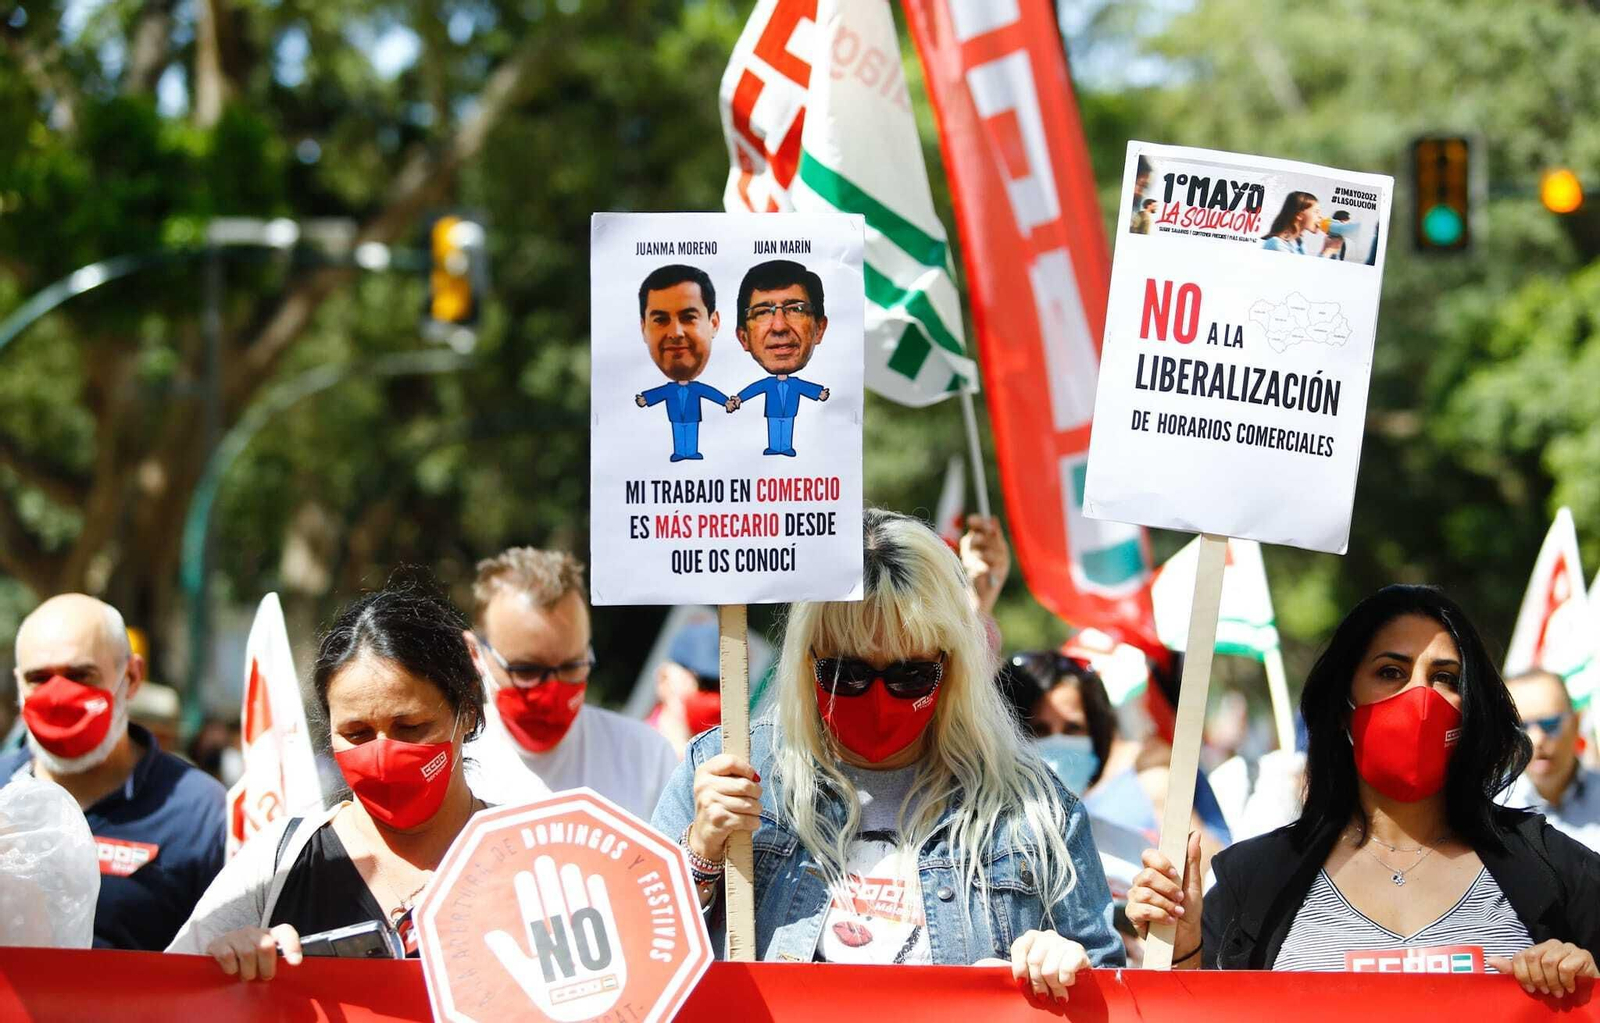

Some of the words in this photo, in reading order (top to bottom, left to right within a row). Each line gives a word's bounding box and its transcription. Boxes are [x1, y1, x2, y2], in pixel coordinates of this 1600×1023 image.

[1155, 201, 1180, 225] LA
[636, 241, 675, 256] JUANMA
[678, 241, 718, 256] MORENO
[754, 240, 777, 254] JUAN
[780, 238, 811, 254] MARÍN
[1140, 278, 1202, 344] NO
[1207, 322, 1218, 345] A
[1224, 324, 1244, 349] LA
[1135, 353, 1341, 417] LIBERALIZACIÓN
[1131, 410, 1151, 432] DE
[1157, 412, 1232, 442] HORARIOS
[1236, 423, 1334, 458] COMERCIALES
[626, 480, 645, 504] MI
[651, 479, 724, 504] TRABAJO
[730, 479, 751, 503] EN
[757, 477, 840, 502] COMERCIO
[630, 515, 650, 539] ES
[655, 510, 692, 539] MÁS
[699, 513, 779, 538] PRECARIO
[785, 512, 836, 537] DESDE
[672, 549, 703, 574] QUE
[709, 549, 730, 573] OS
[735, 543, 796, 573] CONOCÍ
[521, 822, 628, 860] DOMINGOS
[628, 855, 645, 870] Y
[637, 871, 676, 963] FESTIVOS
[530, 907, 613, 984] NO
